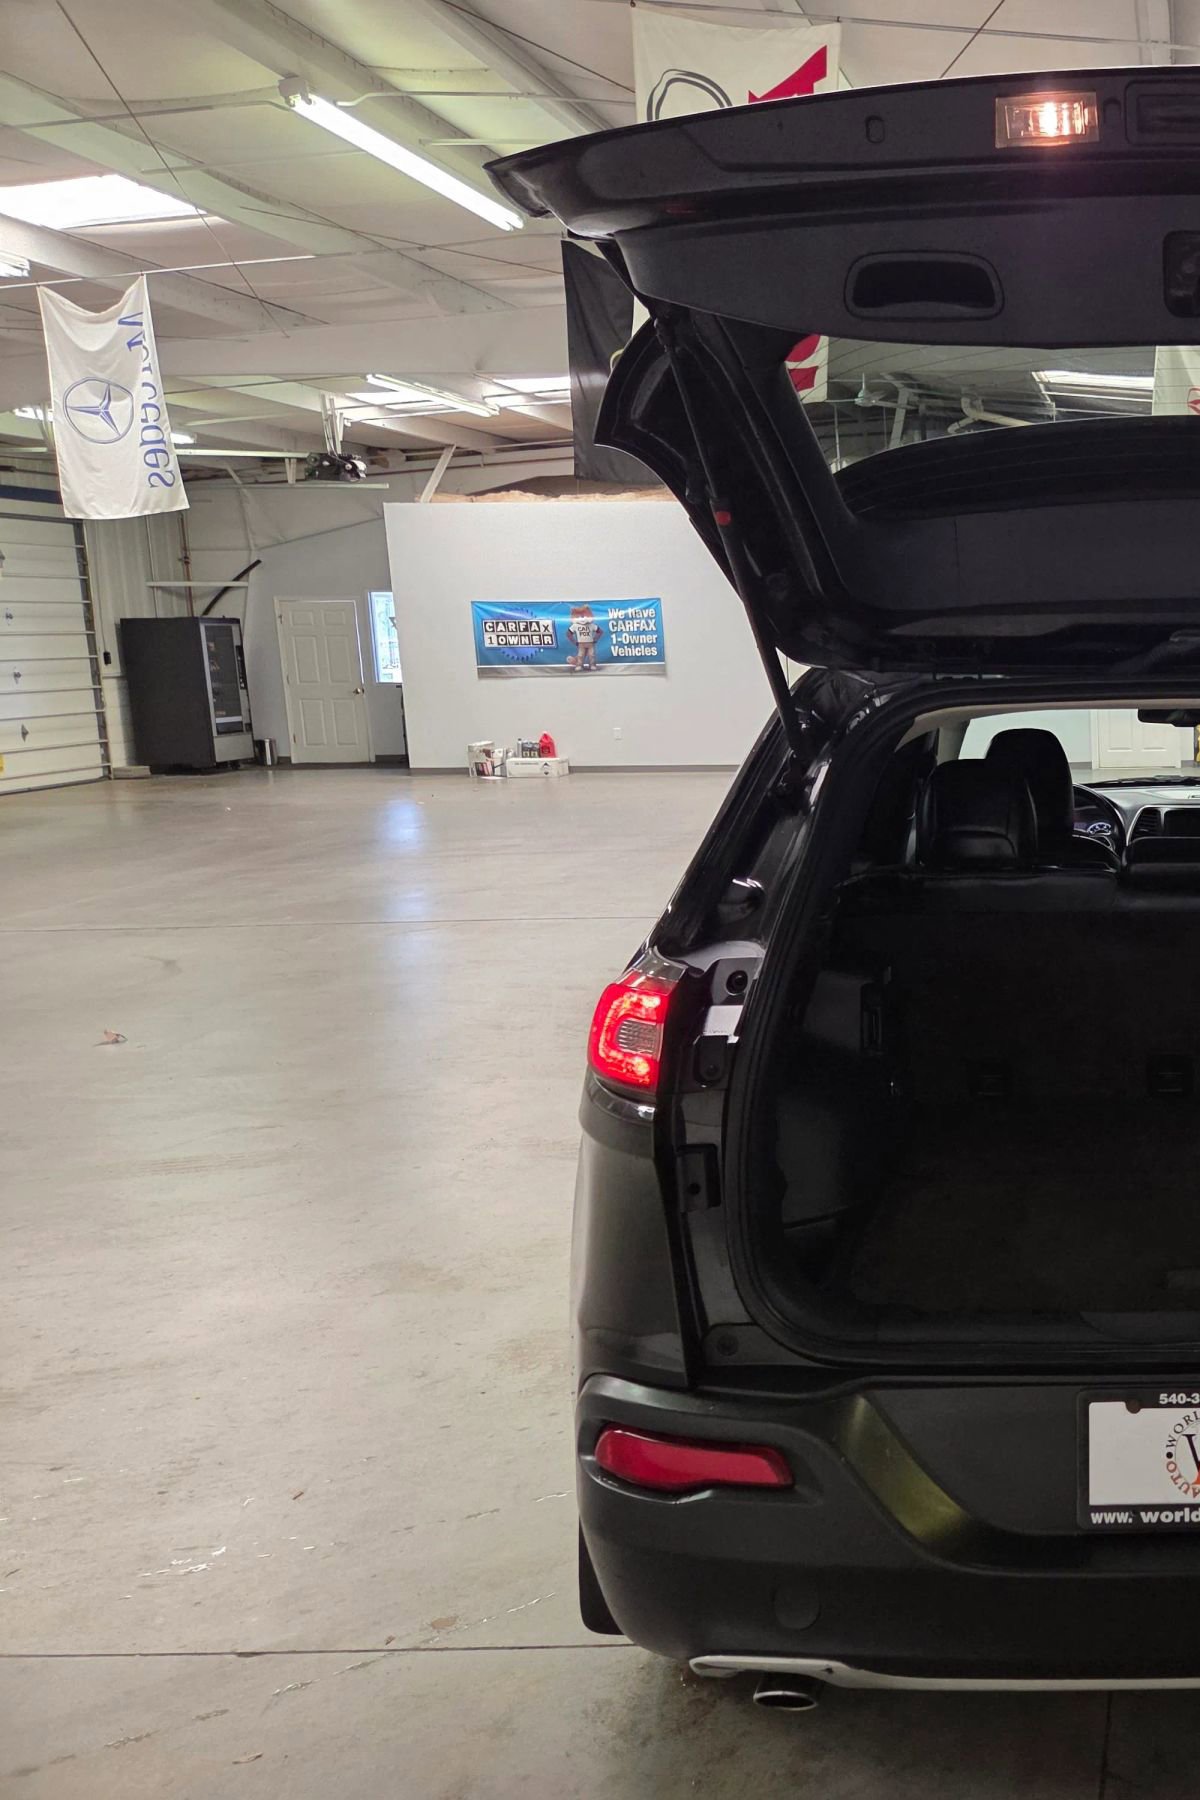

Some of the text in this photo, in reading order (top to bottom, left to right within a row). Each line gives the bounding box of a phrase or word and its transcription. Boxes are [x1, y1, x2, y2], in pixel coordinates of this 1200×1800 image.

[608, 607, 656, 619] We have
[485, 622, 550, 633] CARFAX
[609, 619, 657, 632] CARFAX
[498, 635, 552, 645] OWNER
[611, 633, 658, 644] 1-Owner
[611, 645, 658, 657] Vehicles
[1091, 1510, 1133, 1524] www.
